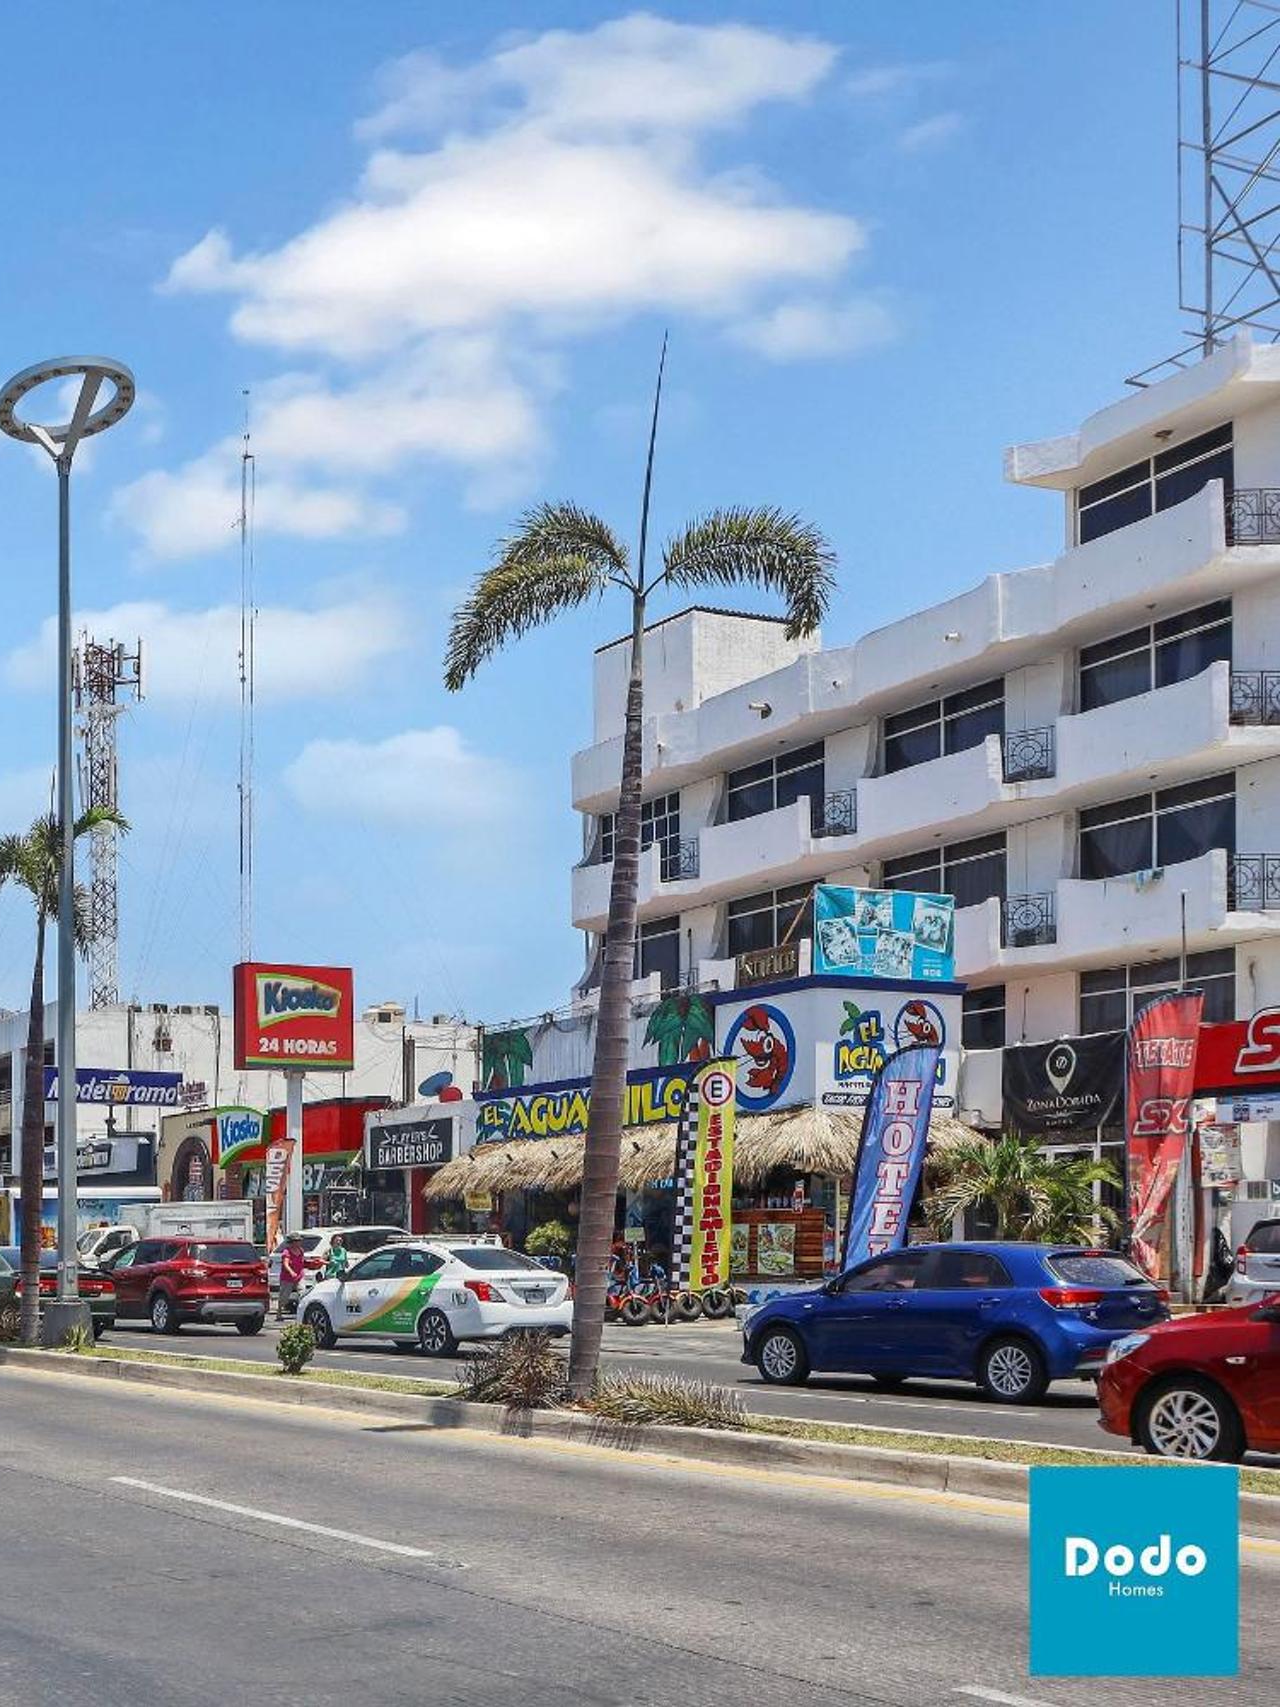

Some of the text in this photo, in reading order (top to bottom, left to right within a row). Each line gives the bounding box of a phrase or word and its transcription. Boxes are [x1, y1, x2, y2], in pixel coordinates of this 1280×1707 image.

[264, 981, 337, 1015] Kiosko
[259, 1037, 337, 1055] 24 HORAS
[221, 1112, 261, 1152] Kiosko
[377, 1141, 444, 1165] BARBERSHOP
[699, 1112, 724, 1287] ESTACIONAMIENTO
